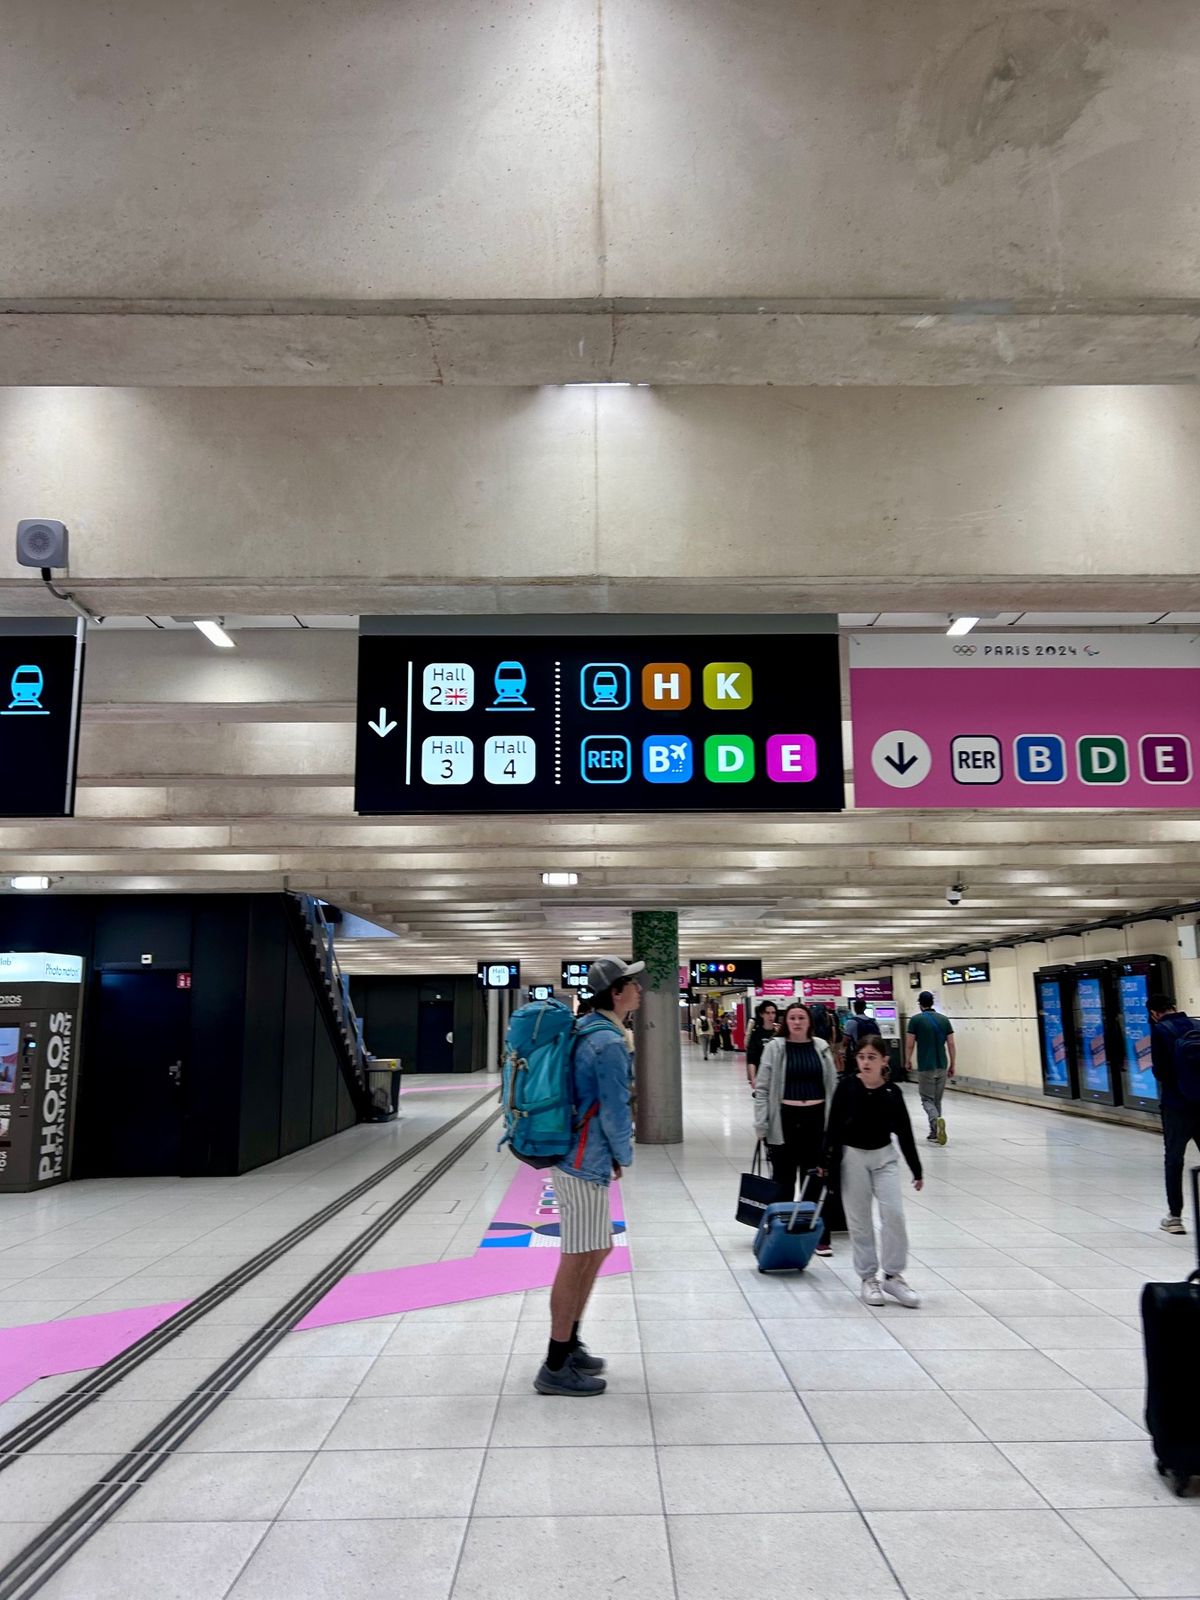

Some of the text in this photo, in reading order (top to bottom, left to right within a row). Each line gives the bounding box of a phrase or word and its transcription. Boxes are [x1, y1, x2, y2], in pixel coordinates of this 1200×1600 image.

[984, 646, 1077, 656] PARIS 2024
[433, 668, 466, 681] Hall
[430, 686, 442, 705] 2
[653, 673, 741, 700] H K
[432, 741, 465, 754] Hall
[494, 741, 527, 754] Hall
[588, 745, 802, 772] RER B D E
[958, 746, 1175, 773] RER B D E
[440, 759, 454, 779] 3
[503, 759, 517, 778] 4
[38, 1012, 66, 1181] PHOTOS
